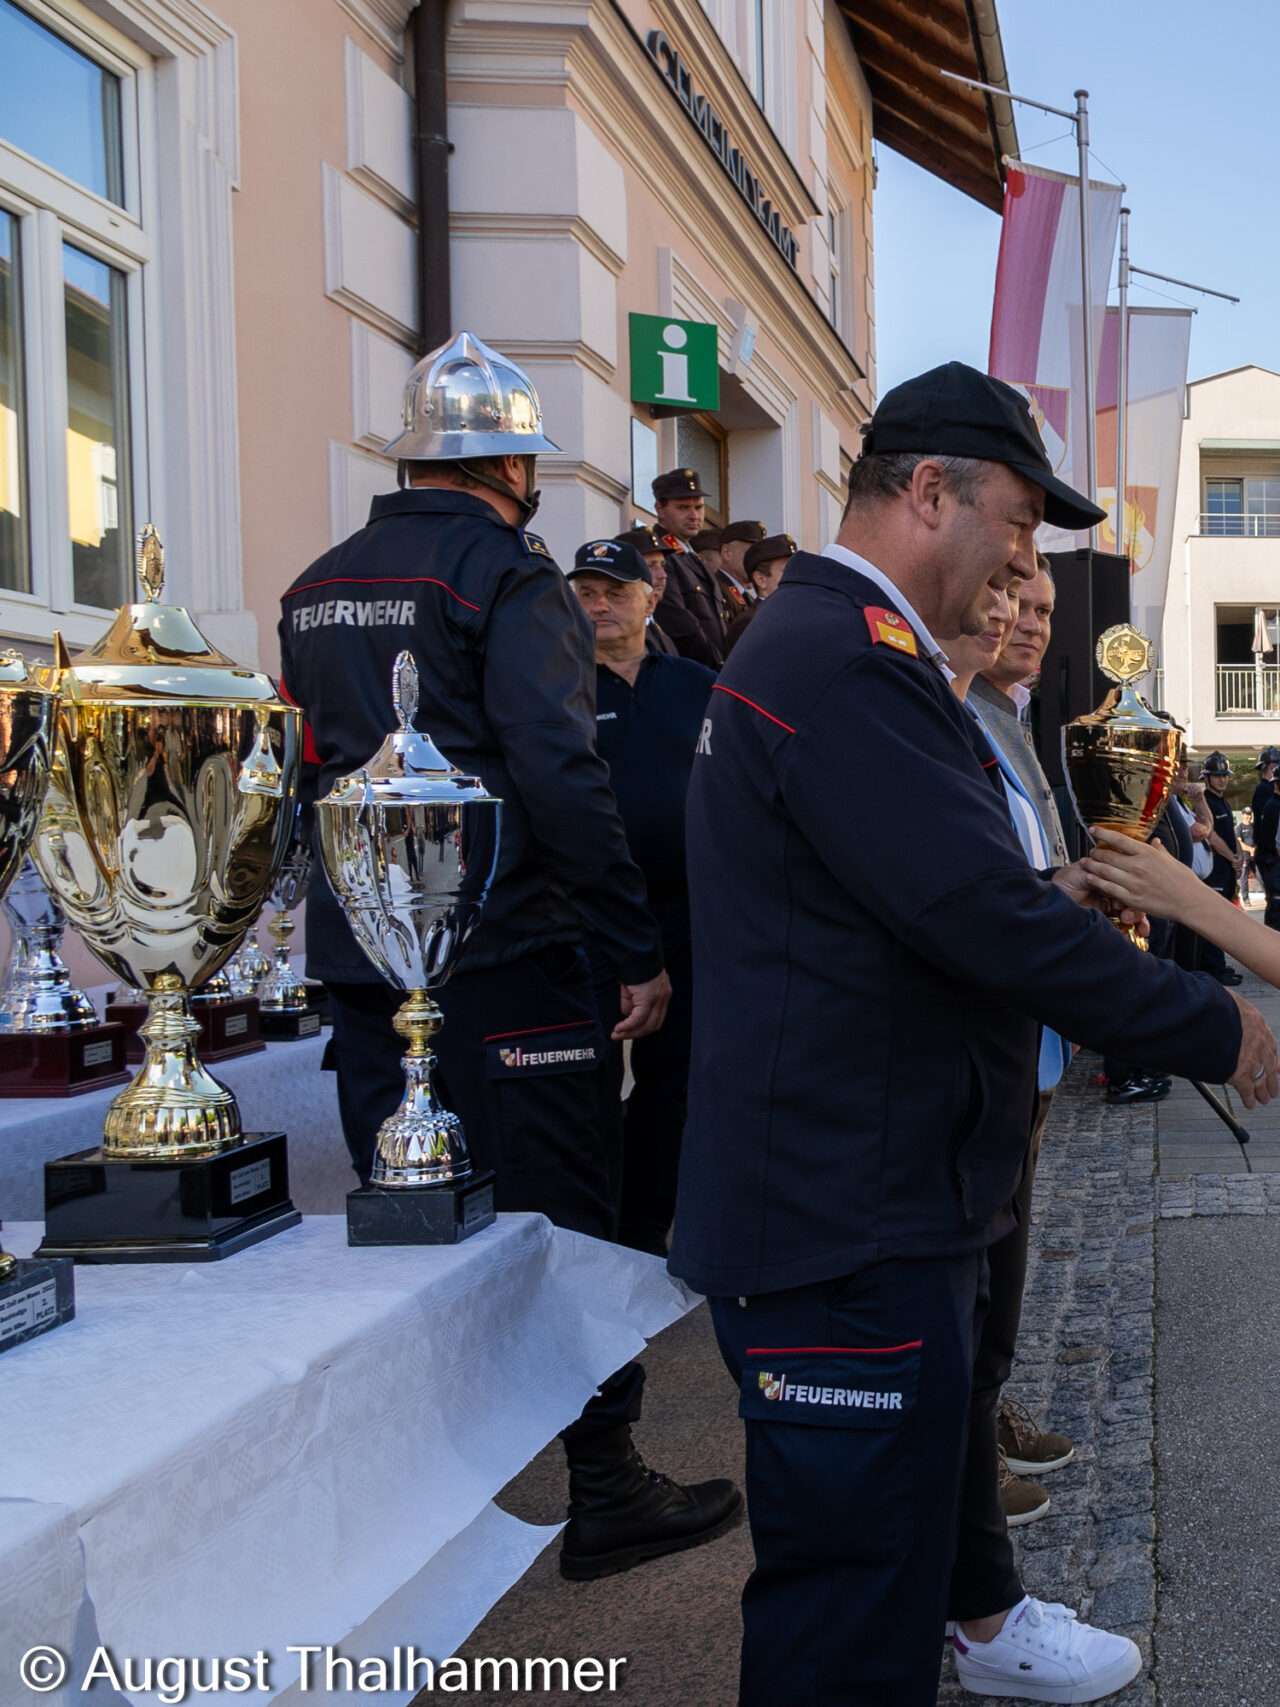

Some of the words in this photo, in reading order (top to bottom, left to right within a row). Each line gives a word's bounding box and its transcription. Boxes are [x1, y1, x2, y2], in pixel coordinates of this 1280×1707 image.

[646, 29, 801, 269] GEMEINDEAMT
[292, 599, 416, 633] FEUERWEHR
[521, 1047, 596, 1067] FEUERWEHR
[784, 1384, 903, 1410] FEUERWEHR
